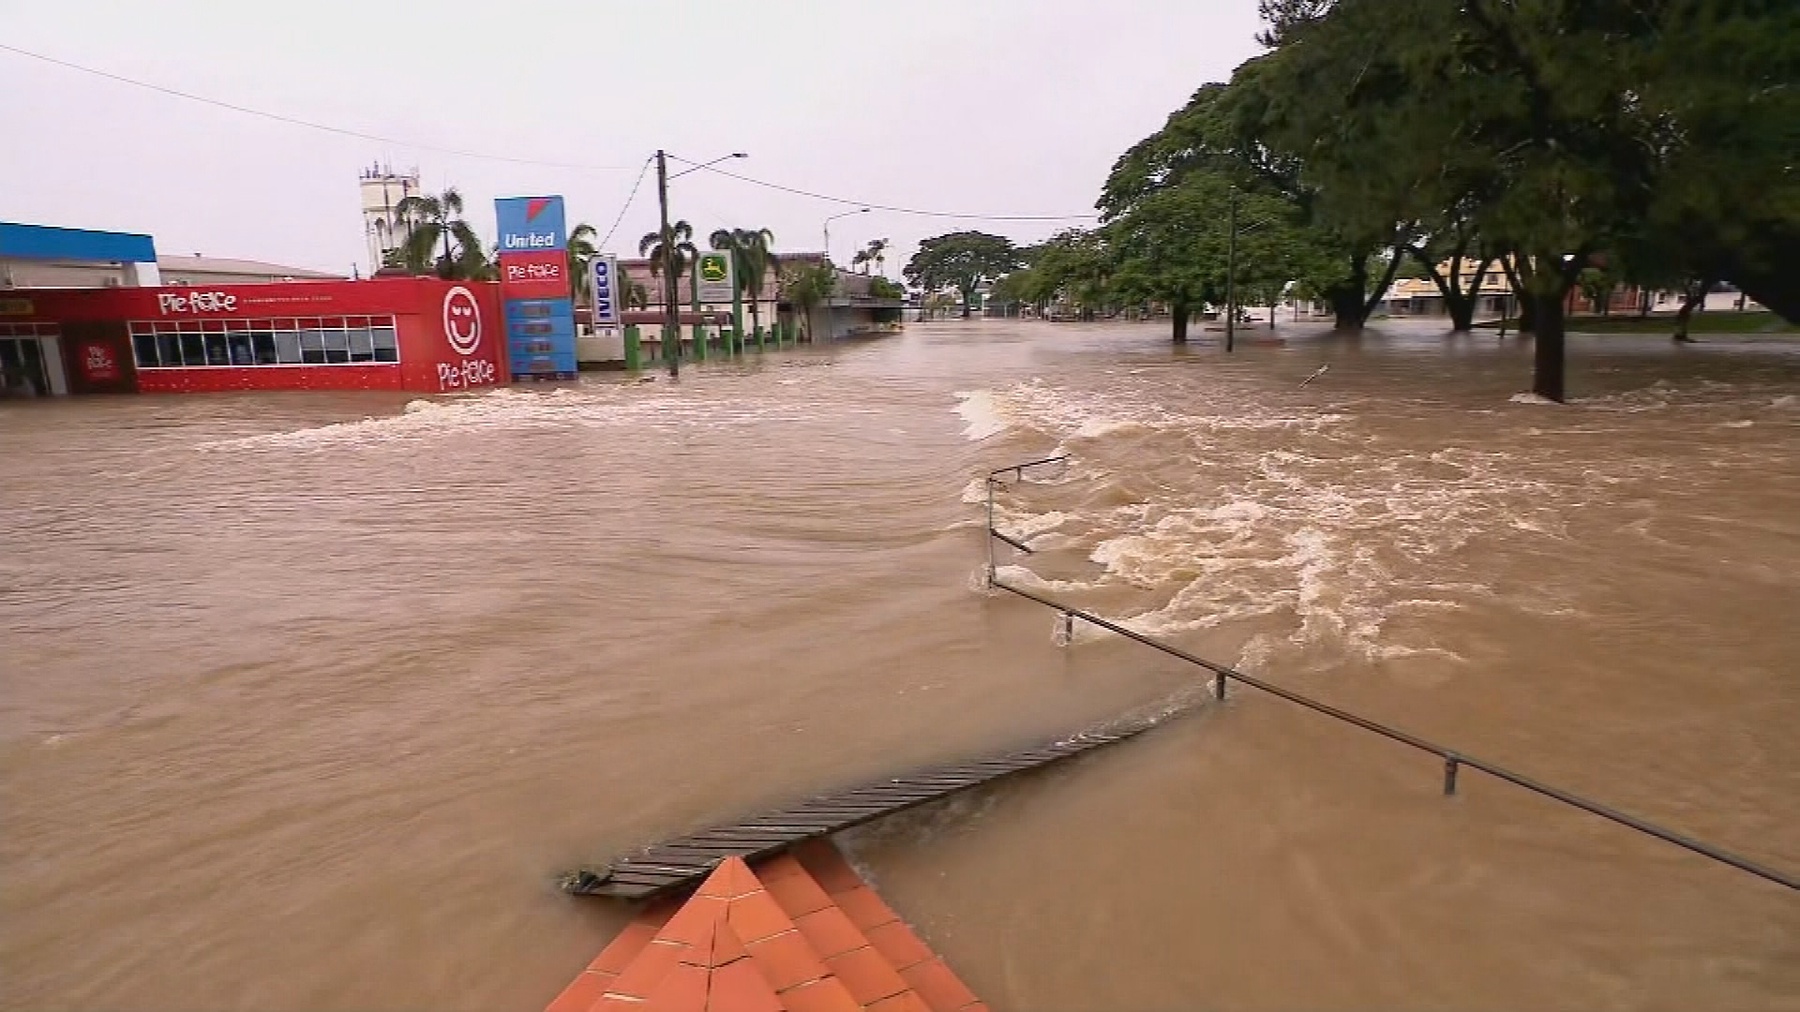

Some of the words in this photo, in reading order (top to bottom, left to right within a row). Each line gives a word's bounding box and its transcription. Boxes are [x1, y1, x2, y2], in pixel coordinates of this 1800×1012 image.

[505, 232, 554, 248] United
[595, 261, 612, 318] IVECO
[157, 293, 187, 315] Pie
[437, 363, 460, 391] Pie
